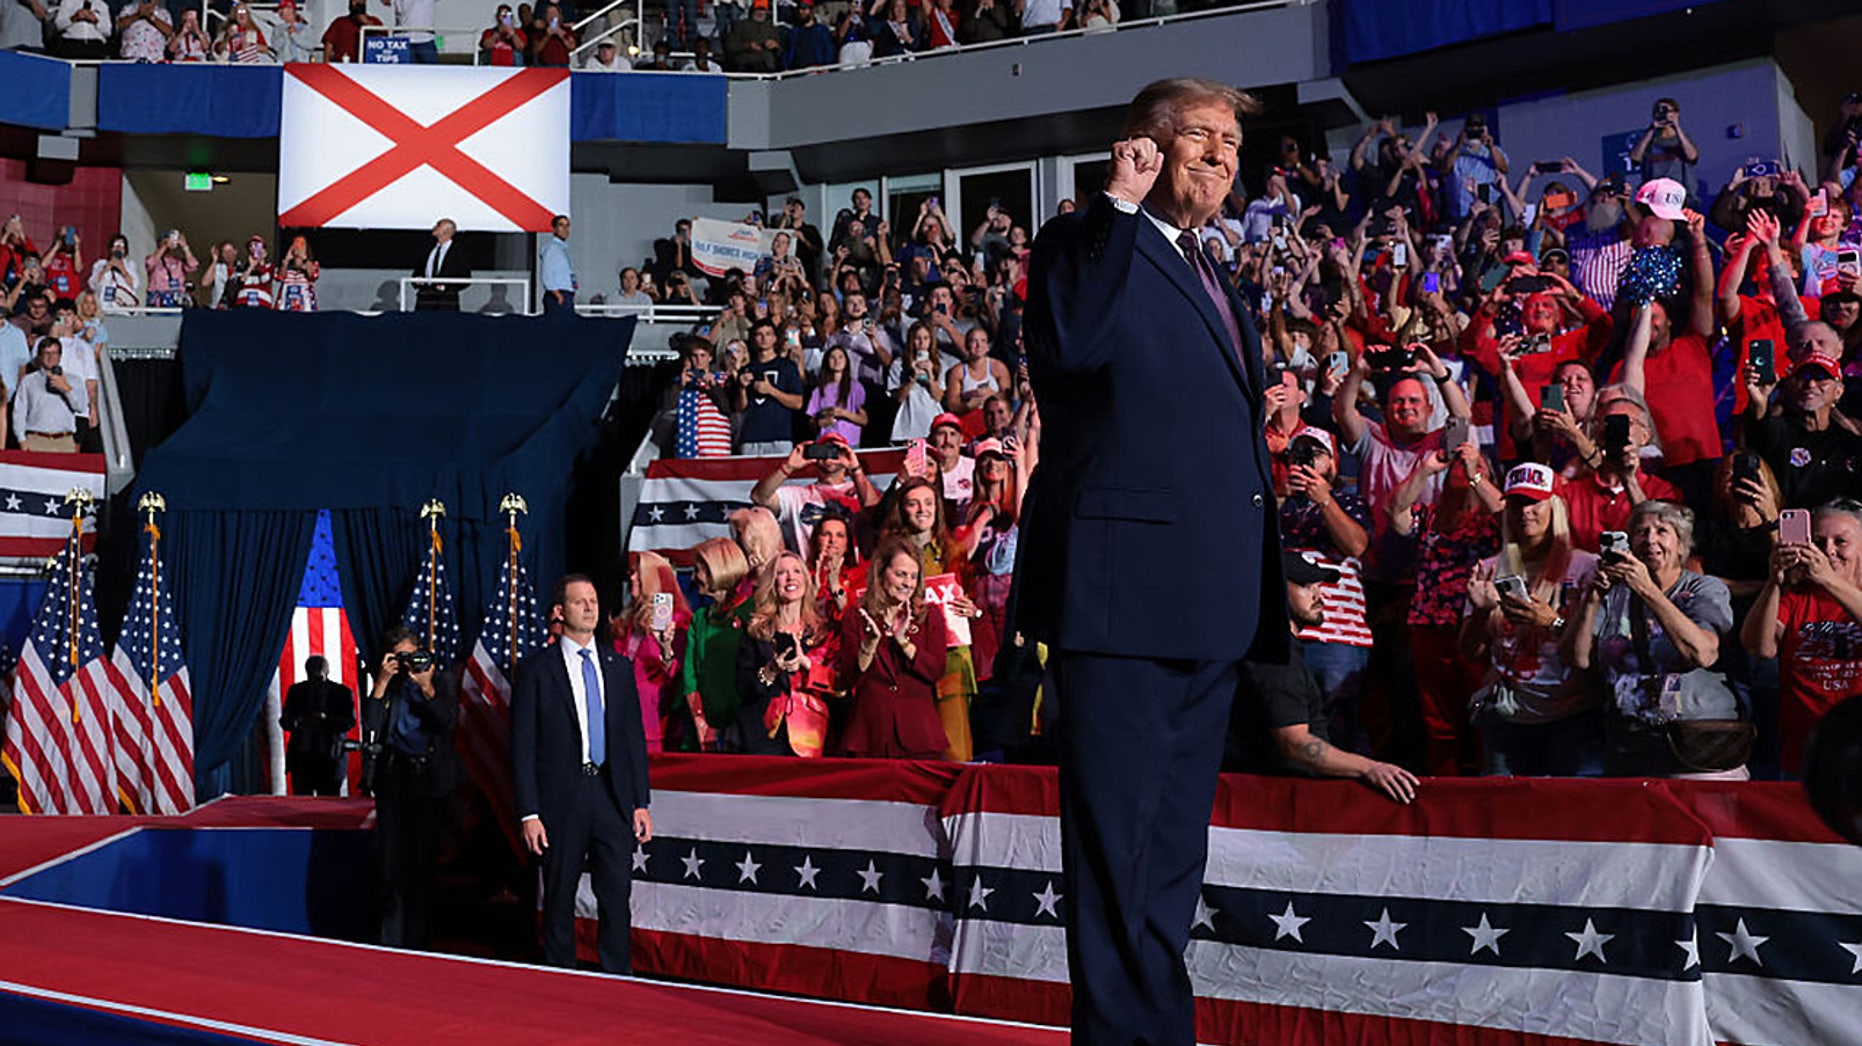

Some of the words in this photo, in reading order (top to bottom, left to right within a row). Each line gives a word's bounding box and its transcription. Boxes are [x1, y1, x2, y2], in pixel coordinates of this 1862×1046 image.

[368, 40, 384, 50] NO
[387, 40, 407, 50] TAX
[925, 584, 955, 605] AX
[1823, 680, 1849, 691] USA
